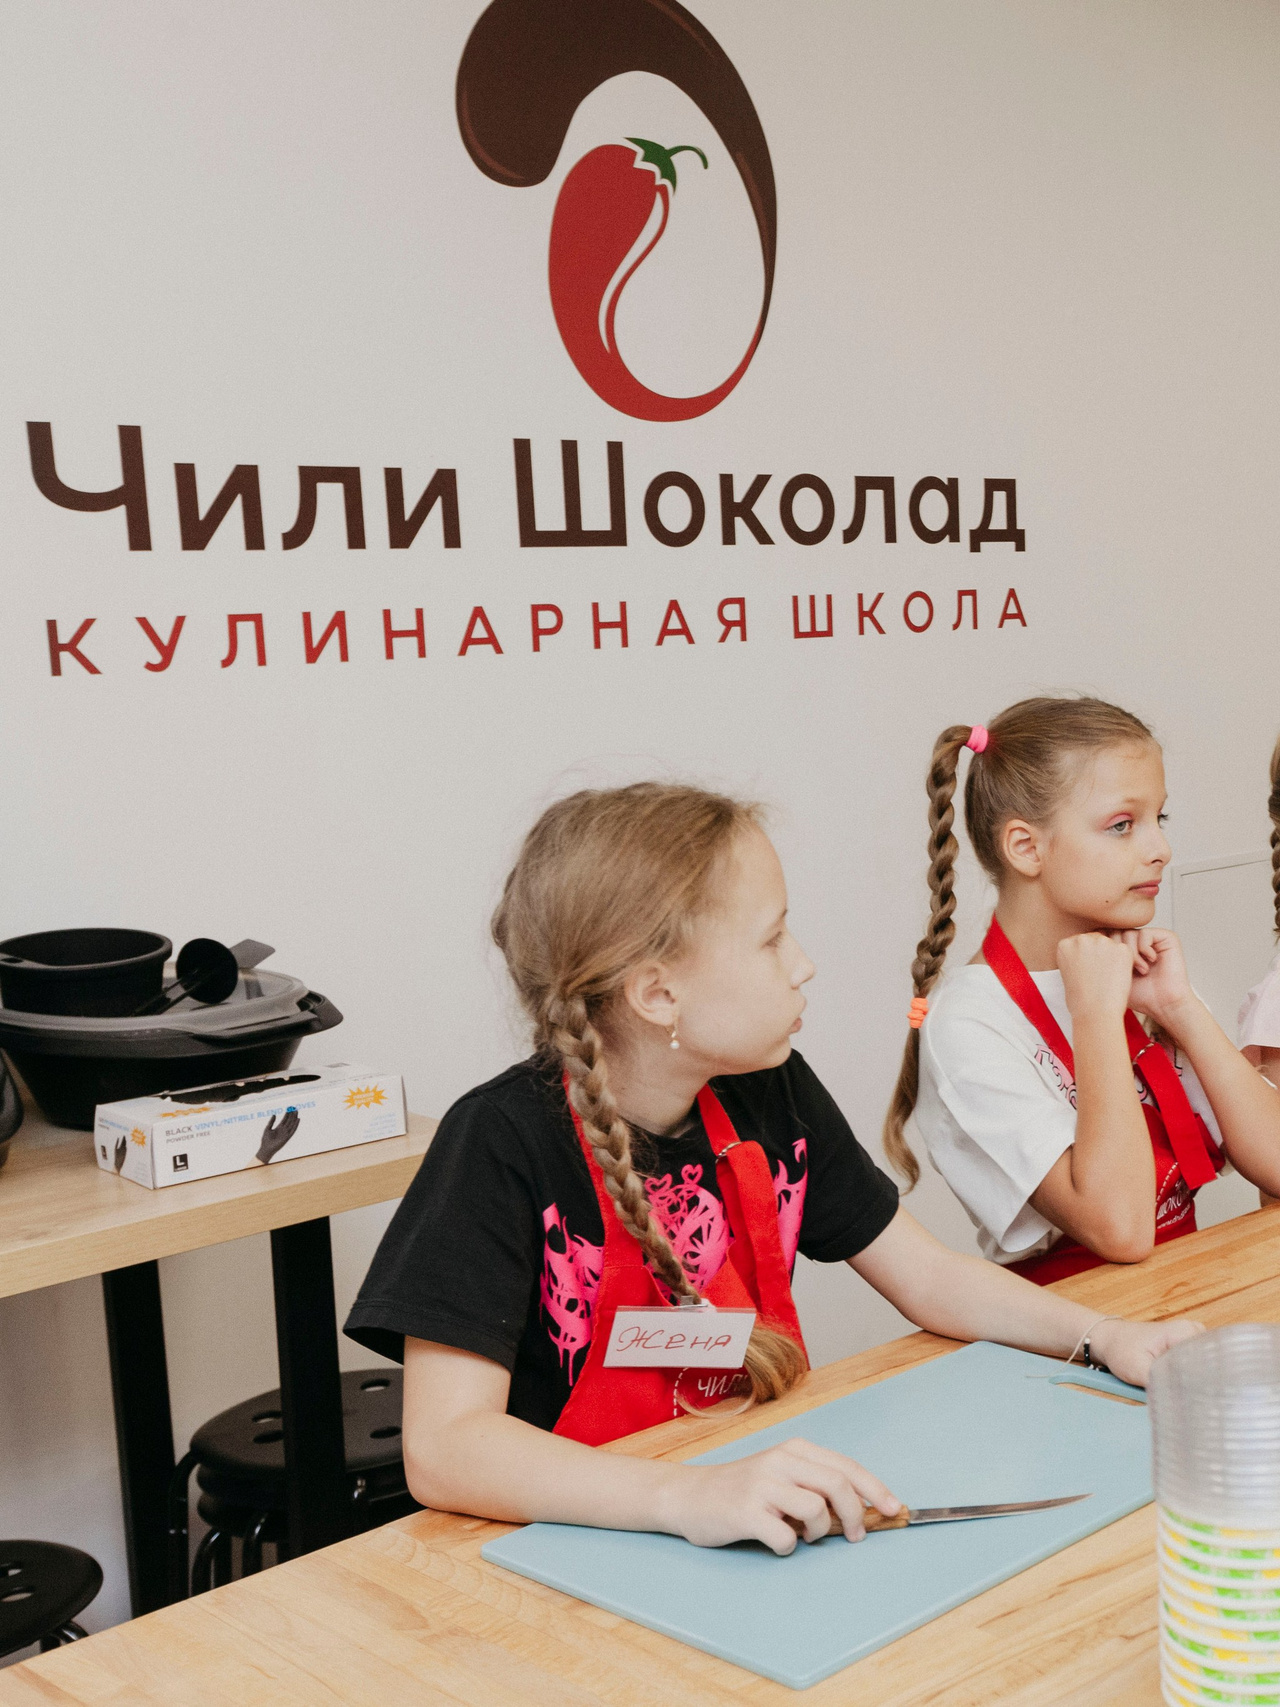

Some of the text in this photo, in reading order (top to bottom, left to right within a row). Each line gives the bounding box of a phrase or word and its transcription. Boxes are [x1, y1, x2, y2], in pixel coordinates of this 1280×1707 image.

[27, 421, 1026, 552] Чили Шоколад
[47, 588, 1027, 676] КУЛИНАРНАЯ ШКОЛА
[165, 1125, 193, 1137] BLACK
[257, 1107, 283, 1119] BLEND
[166, 1131, 211, 1144] POWDER FREE
[176, 1155, 185, 1166] L
[698, 1373, 748, 1397] ЧИЛ
